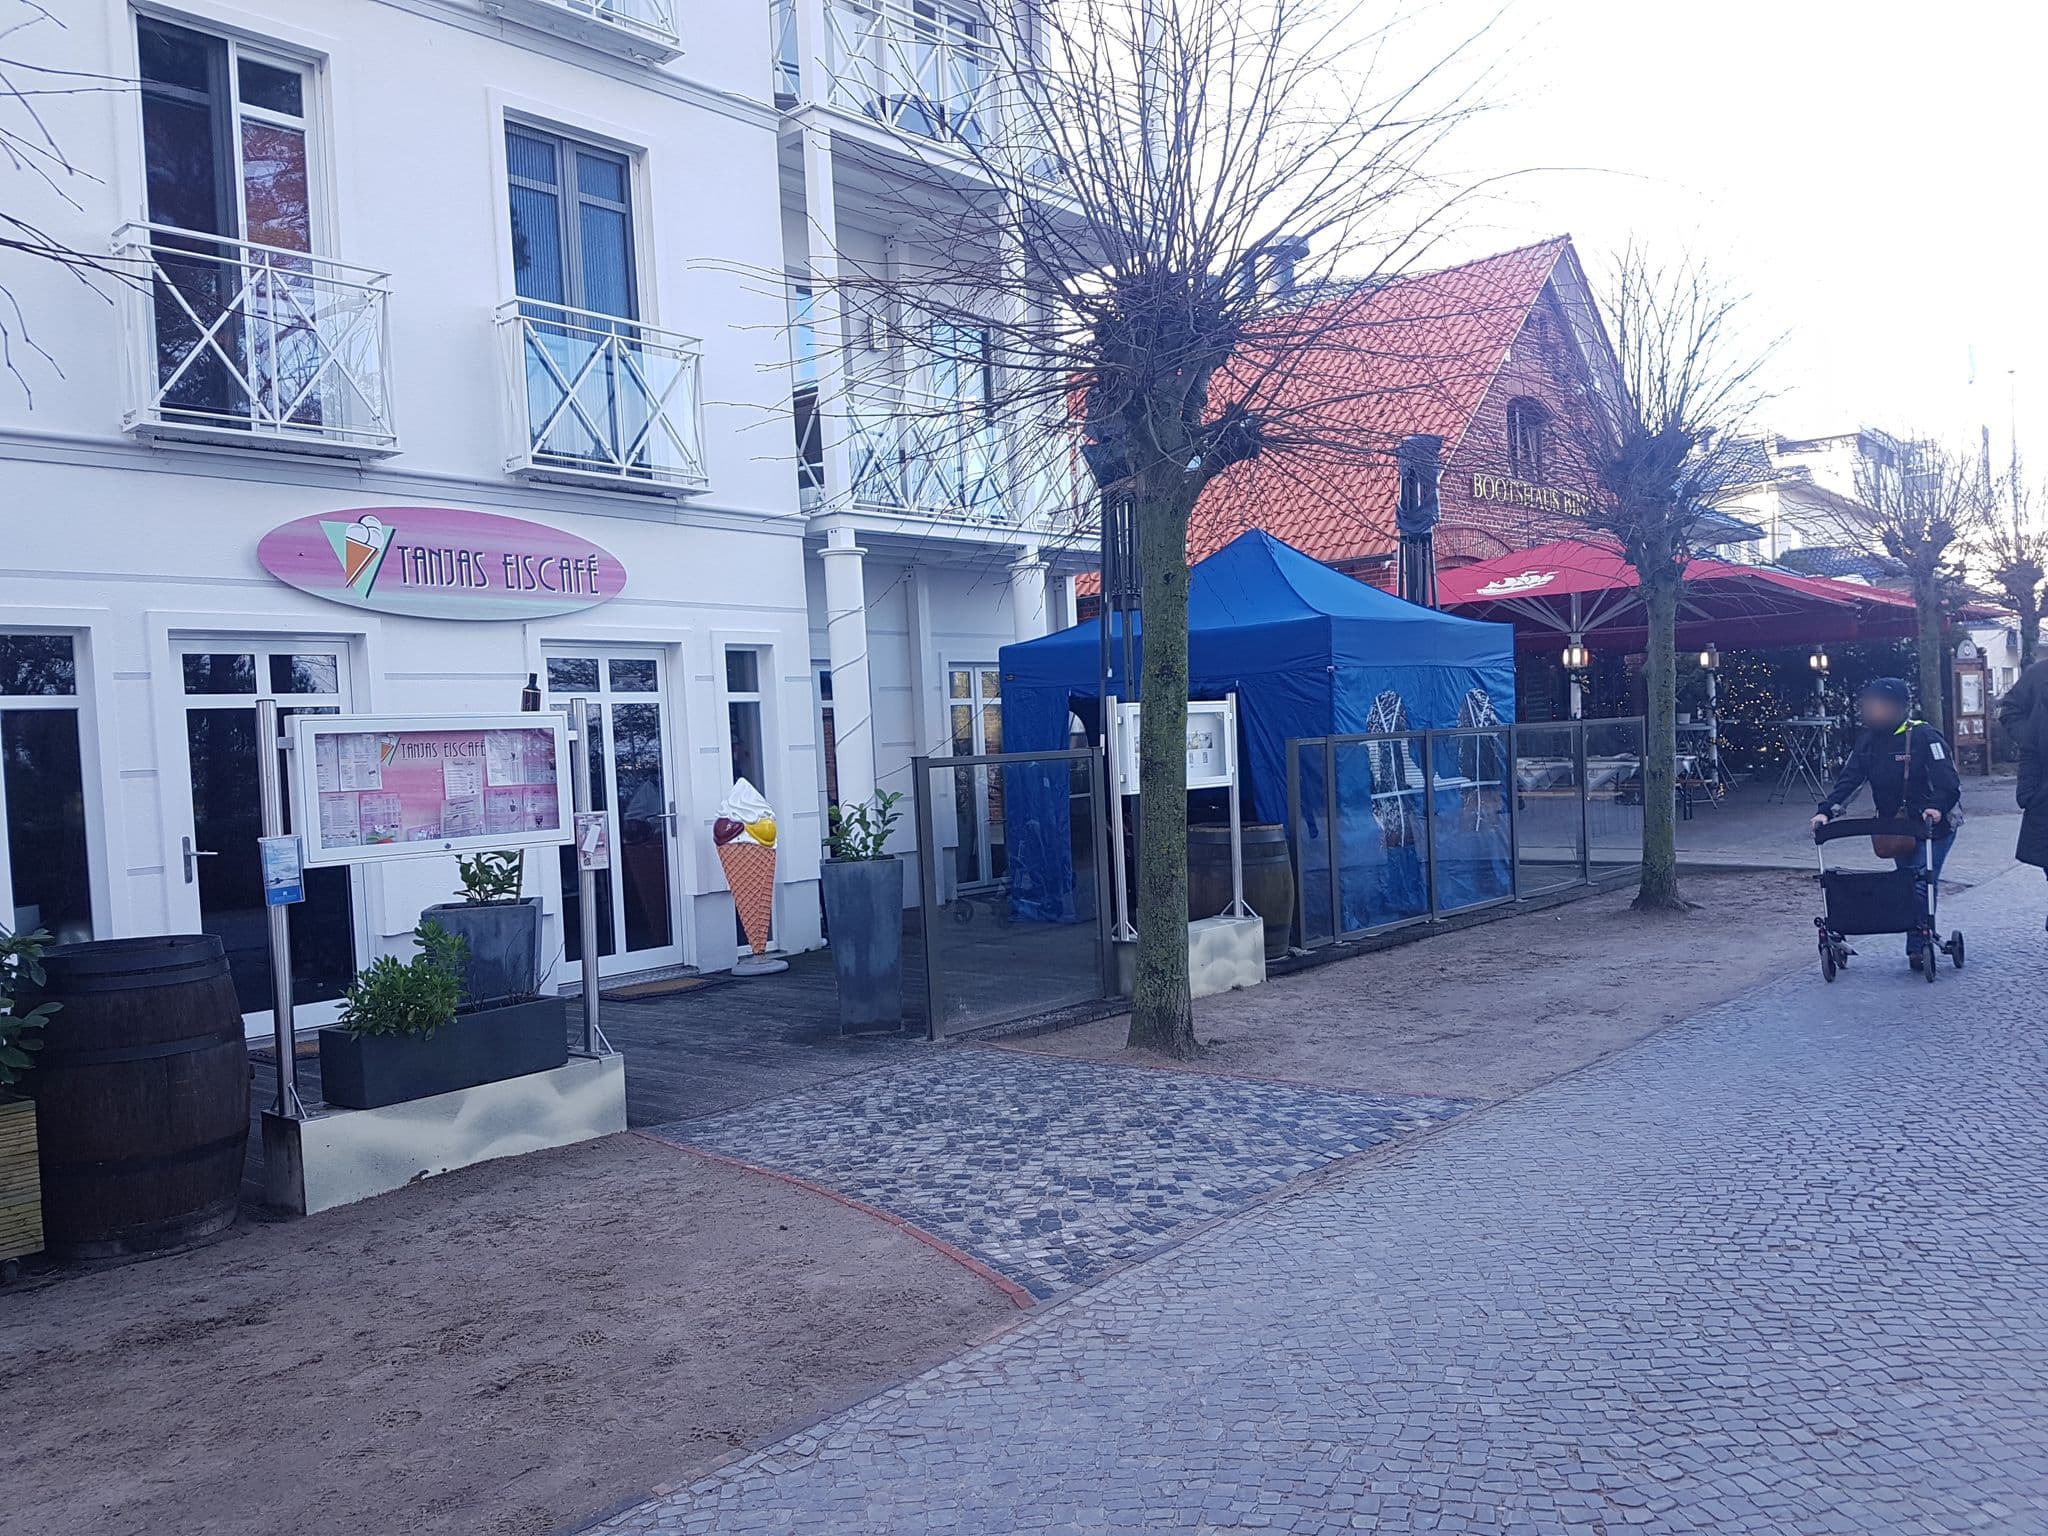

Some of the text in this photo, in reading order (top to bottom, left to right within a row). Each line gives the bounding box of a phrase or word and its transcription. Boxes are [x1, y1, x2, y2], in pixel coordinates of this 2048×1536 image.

[1473, 473, 1560, 512] BOOTSHAUS
[397, 545, 601, 596] TANJAS EISCAFÉ
[401, 742, 438, 759] TANJAS
